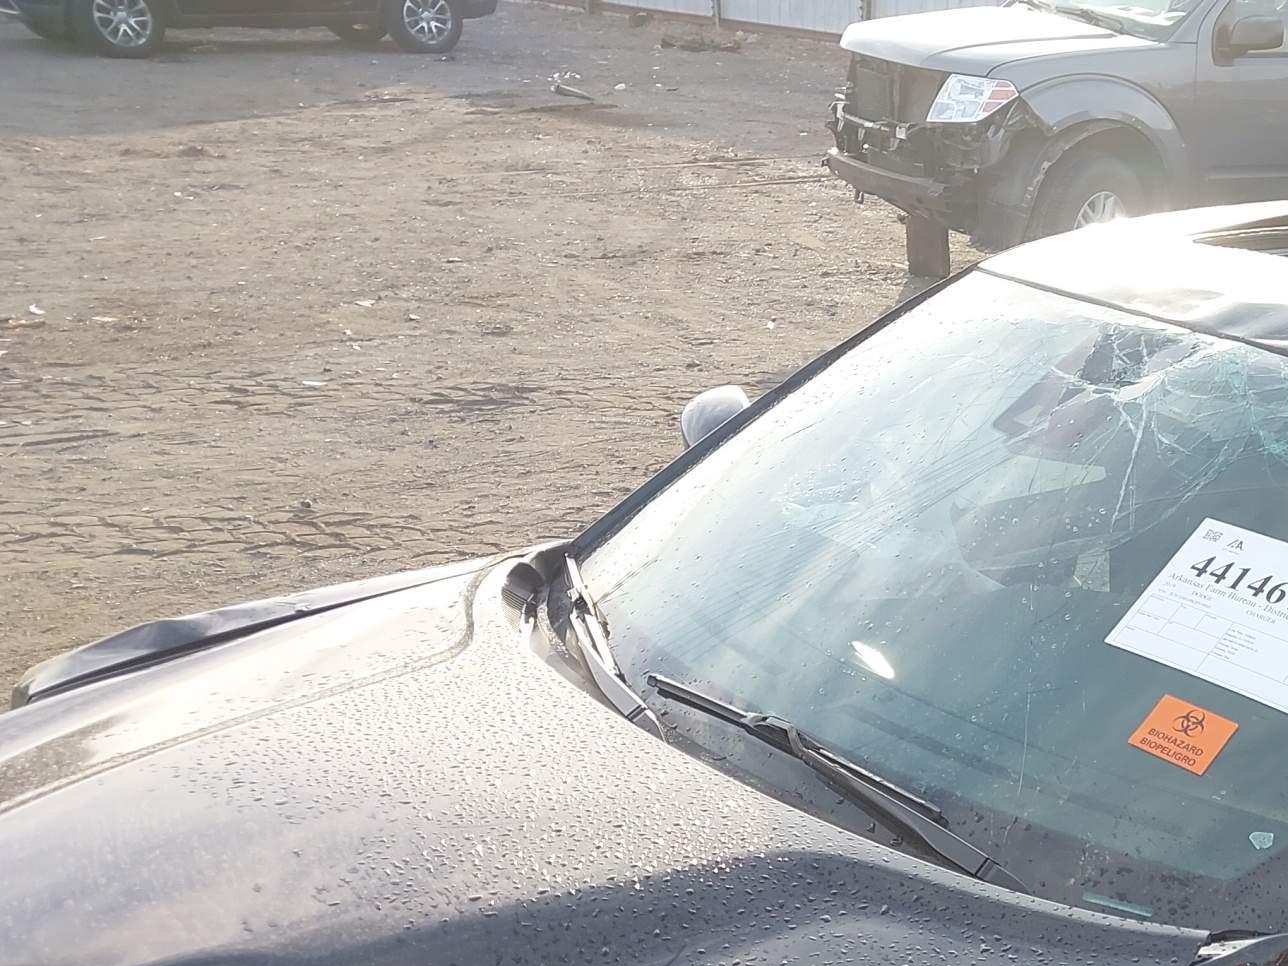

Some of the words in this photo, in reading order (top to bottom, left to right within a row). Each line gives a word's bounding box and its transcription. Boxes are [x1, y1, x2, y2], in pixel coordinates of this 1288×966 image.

[1168, 572, 1204, 589] Arkansas
[1205, 583, 1227, 597] Farm
[1228, 592, 1258, 608] Bureau
[1139, 737, 1197, 767] BIOPELIGRO
[1147, 728, 1204, 757] BIOHAZARD
